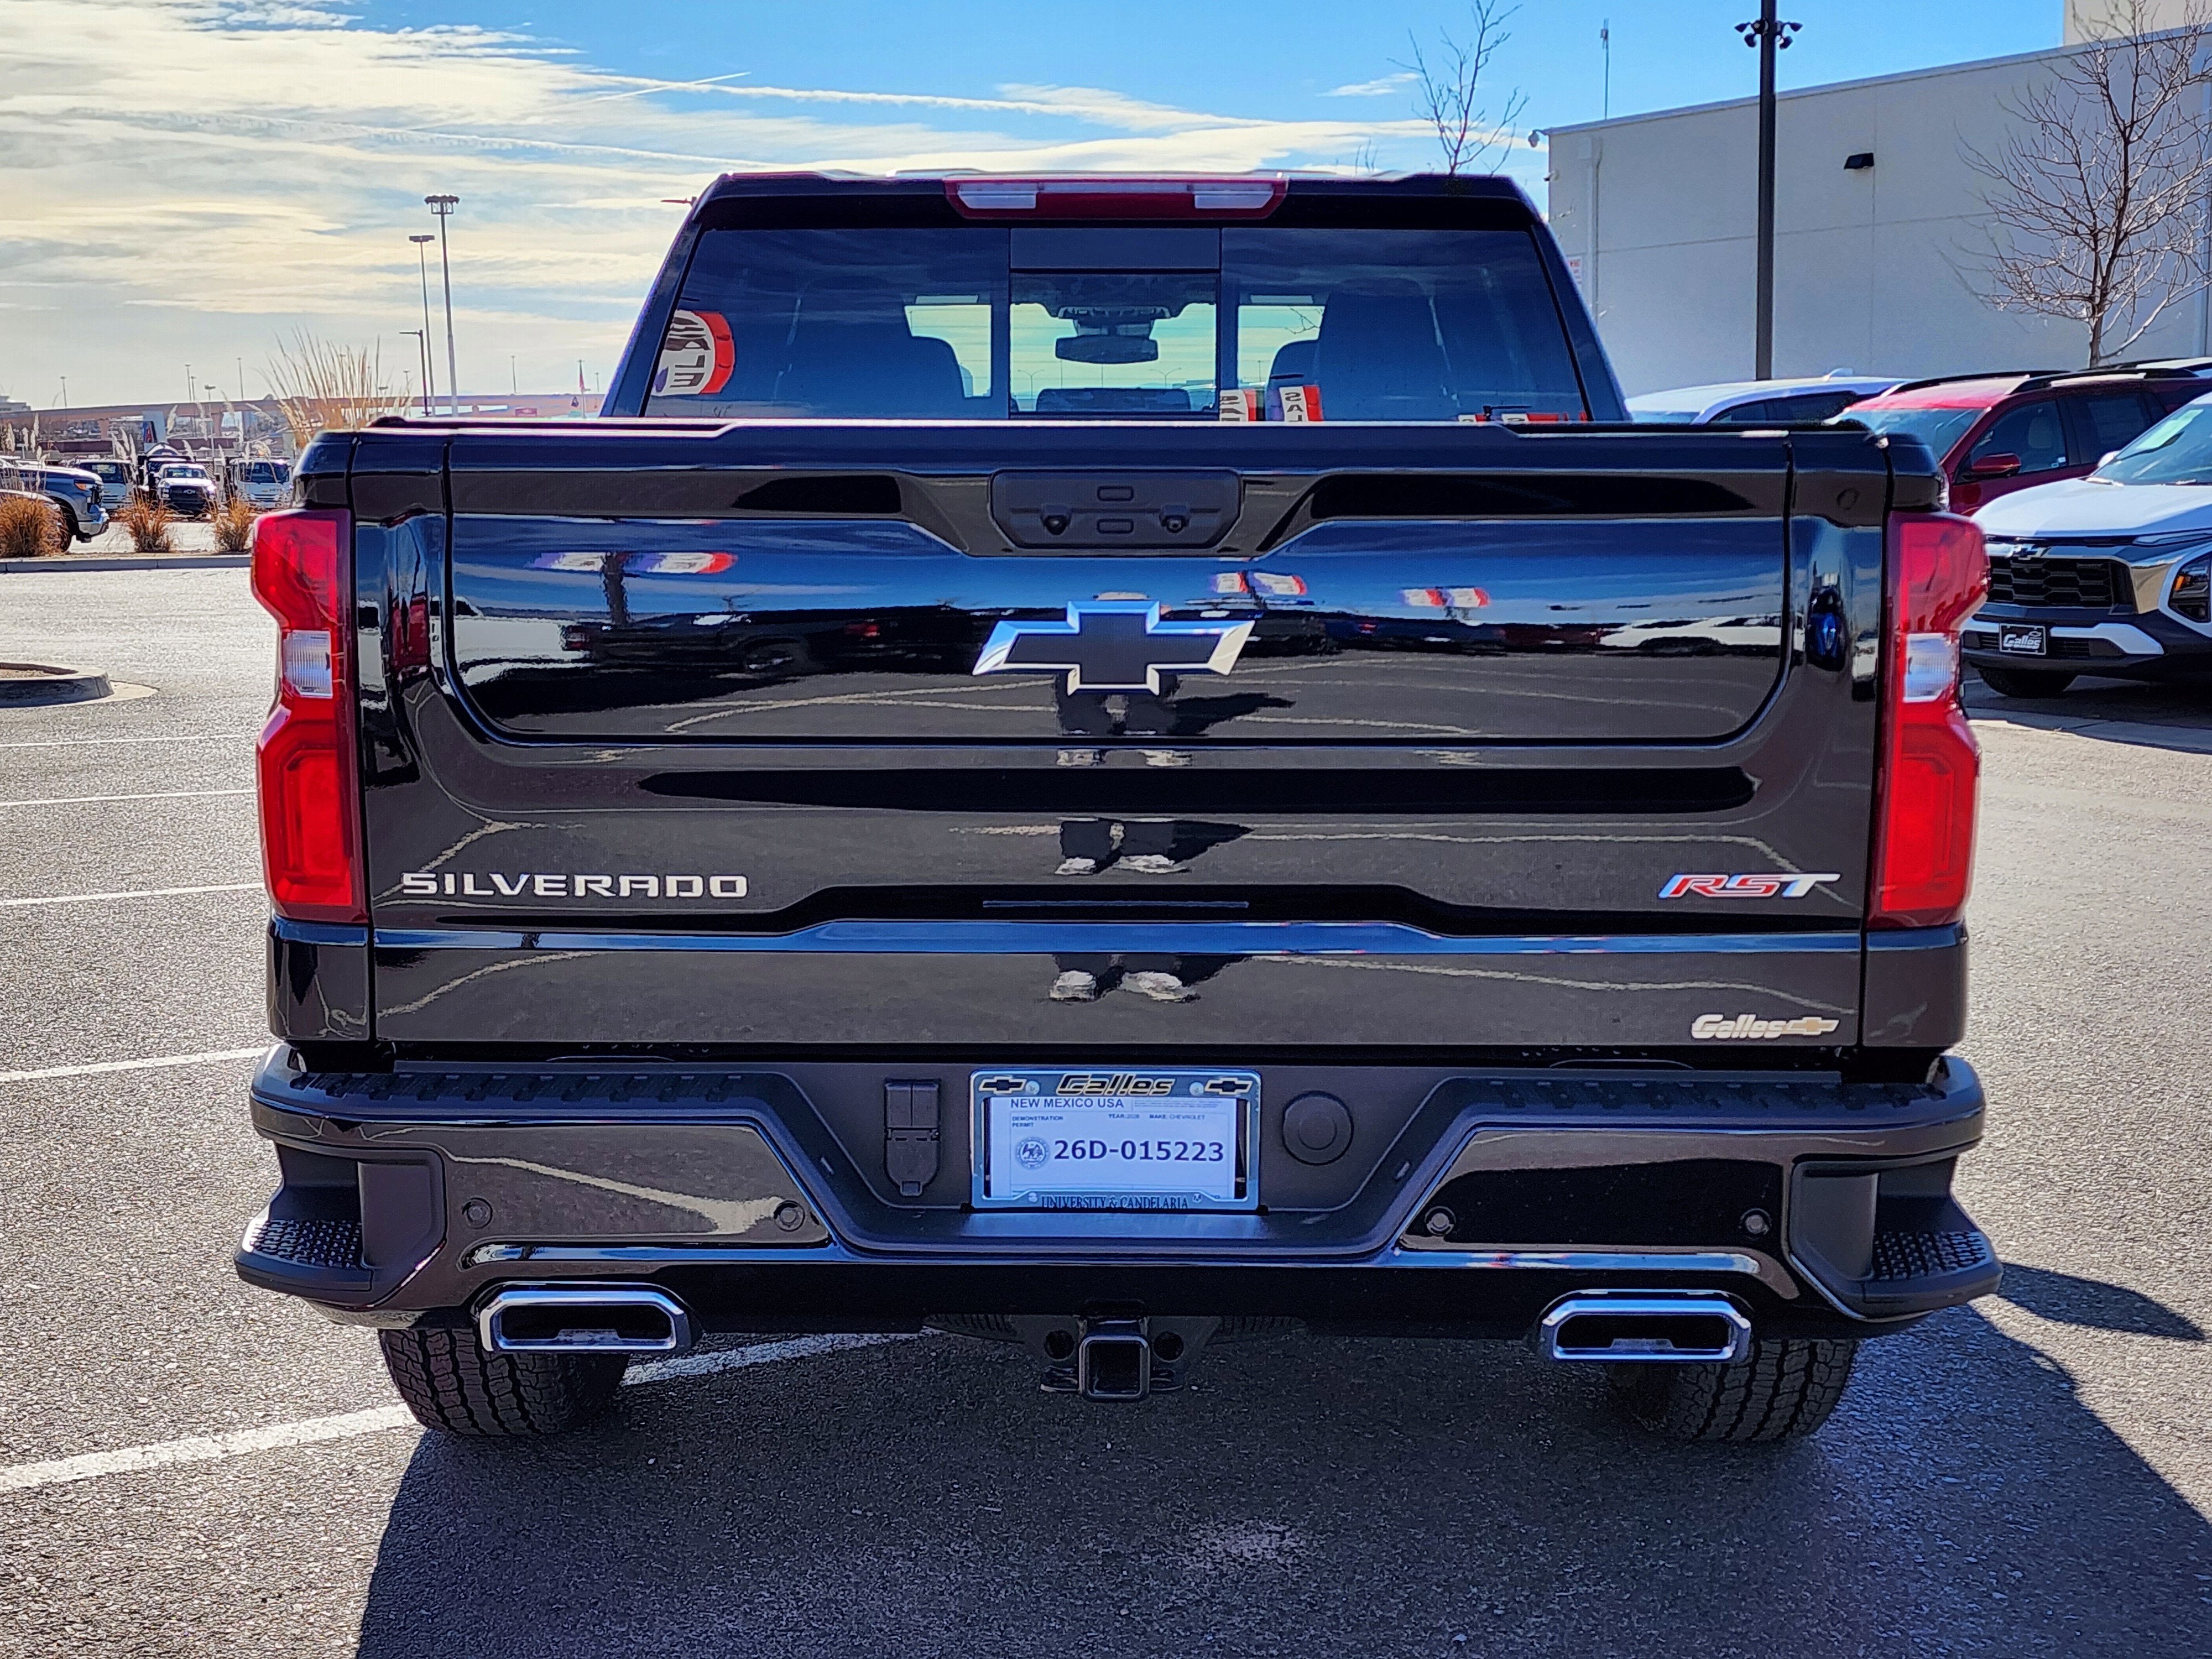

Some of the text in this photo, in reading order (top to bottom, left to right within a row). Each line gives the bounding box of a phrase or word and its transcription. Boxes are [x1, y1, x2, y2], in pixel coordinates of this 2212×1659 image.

[2003, 634, 2041, 649] Galles
[401, 873, 748, 898] SILVERADO
[1658, 874, 1841, 899] RST
[1692, 1014, 1787, 1039] Galles
[1056, 1073, 1176, 1096] Galles
[1011, 1098, 1040, 1108] NEW
[1044, 1098, 1093, 1108] MEXICO
[1098, 1098, 1124, 1108] USA
[1054, 1140, 1224, 1161] 26D-015223
[1041, 1196, 1188, 1209] UNIVERSITY & CANDELARIA
